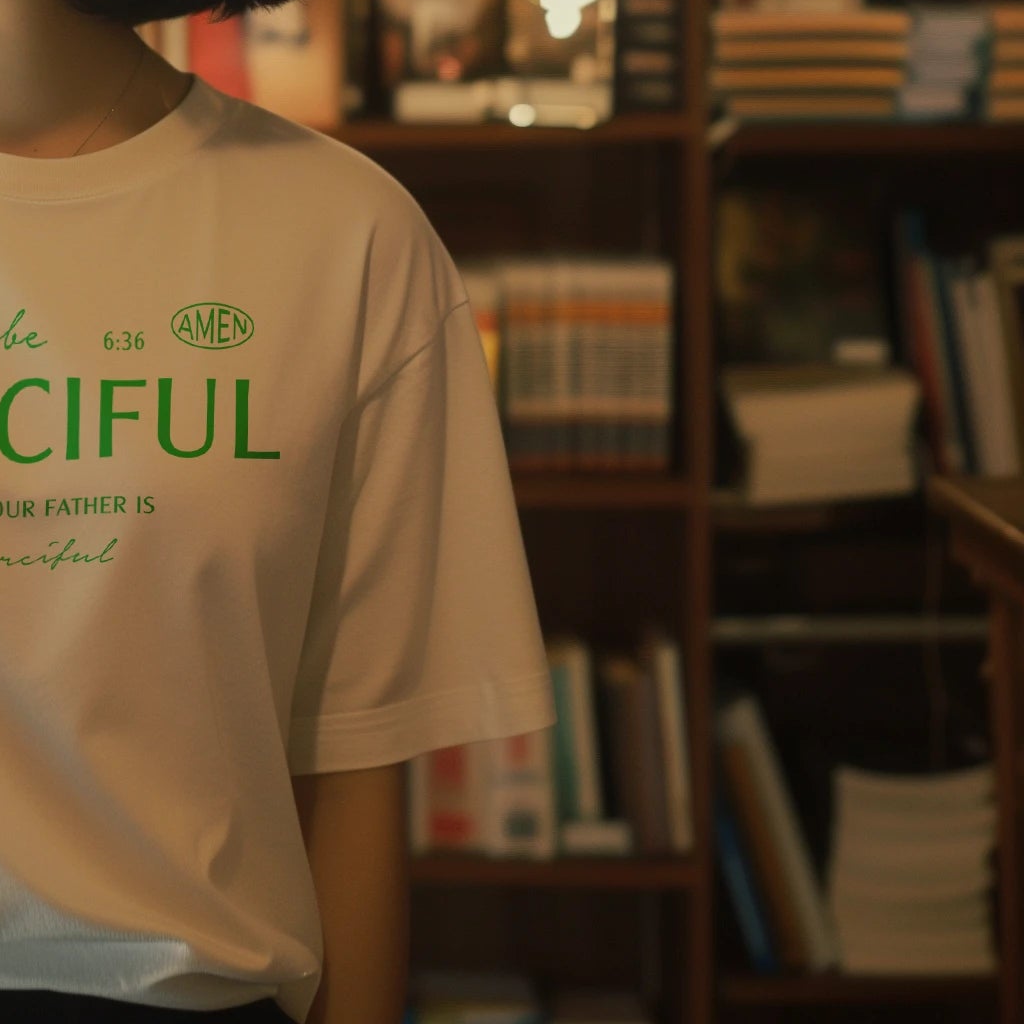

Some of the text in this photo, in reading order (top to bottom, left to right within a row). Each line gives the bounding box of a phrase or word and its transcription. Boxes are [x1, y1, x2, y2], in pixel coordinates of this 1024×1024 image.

[178, 307, 247, 344] AMEN
[103, 330, 145, 351] 6:36
[45, 495, 127, 518] FATHER
[136, 495, 156, 515] IS
